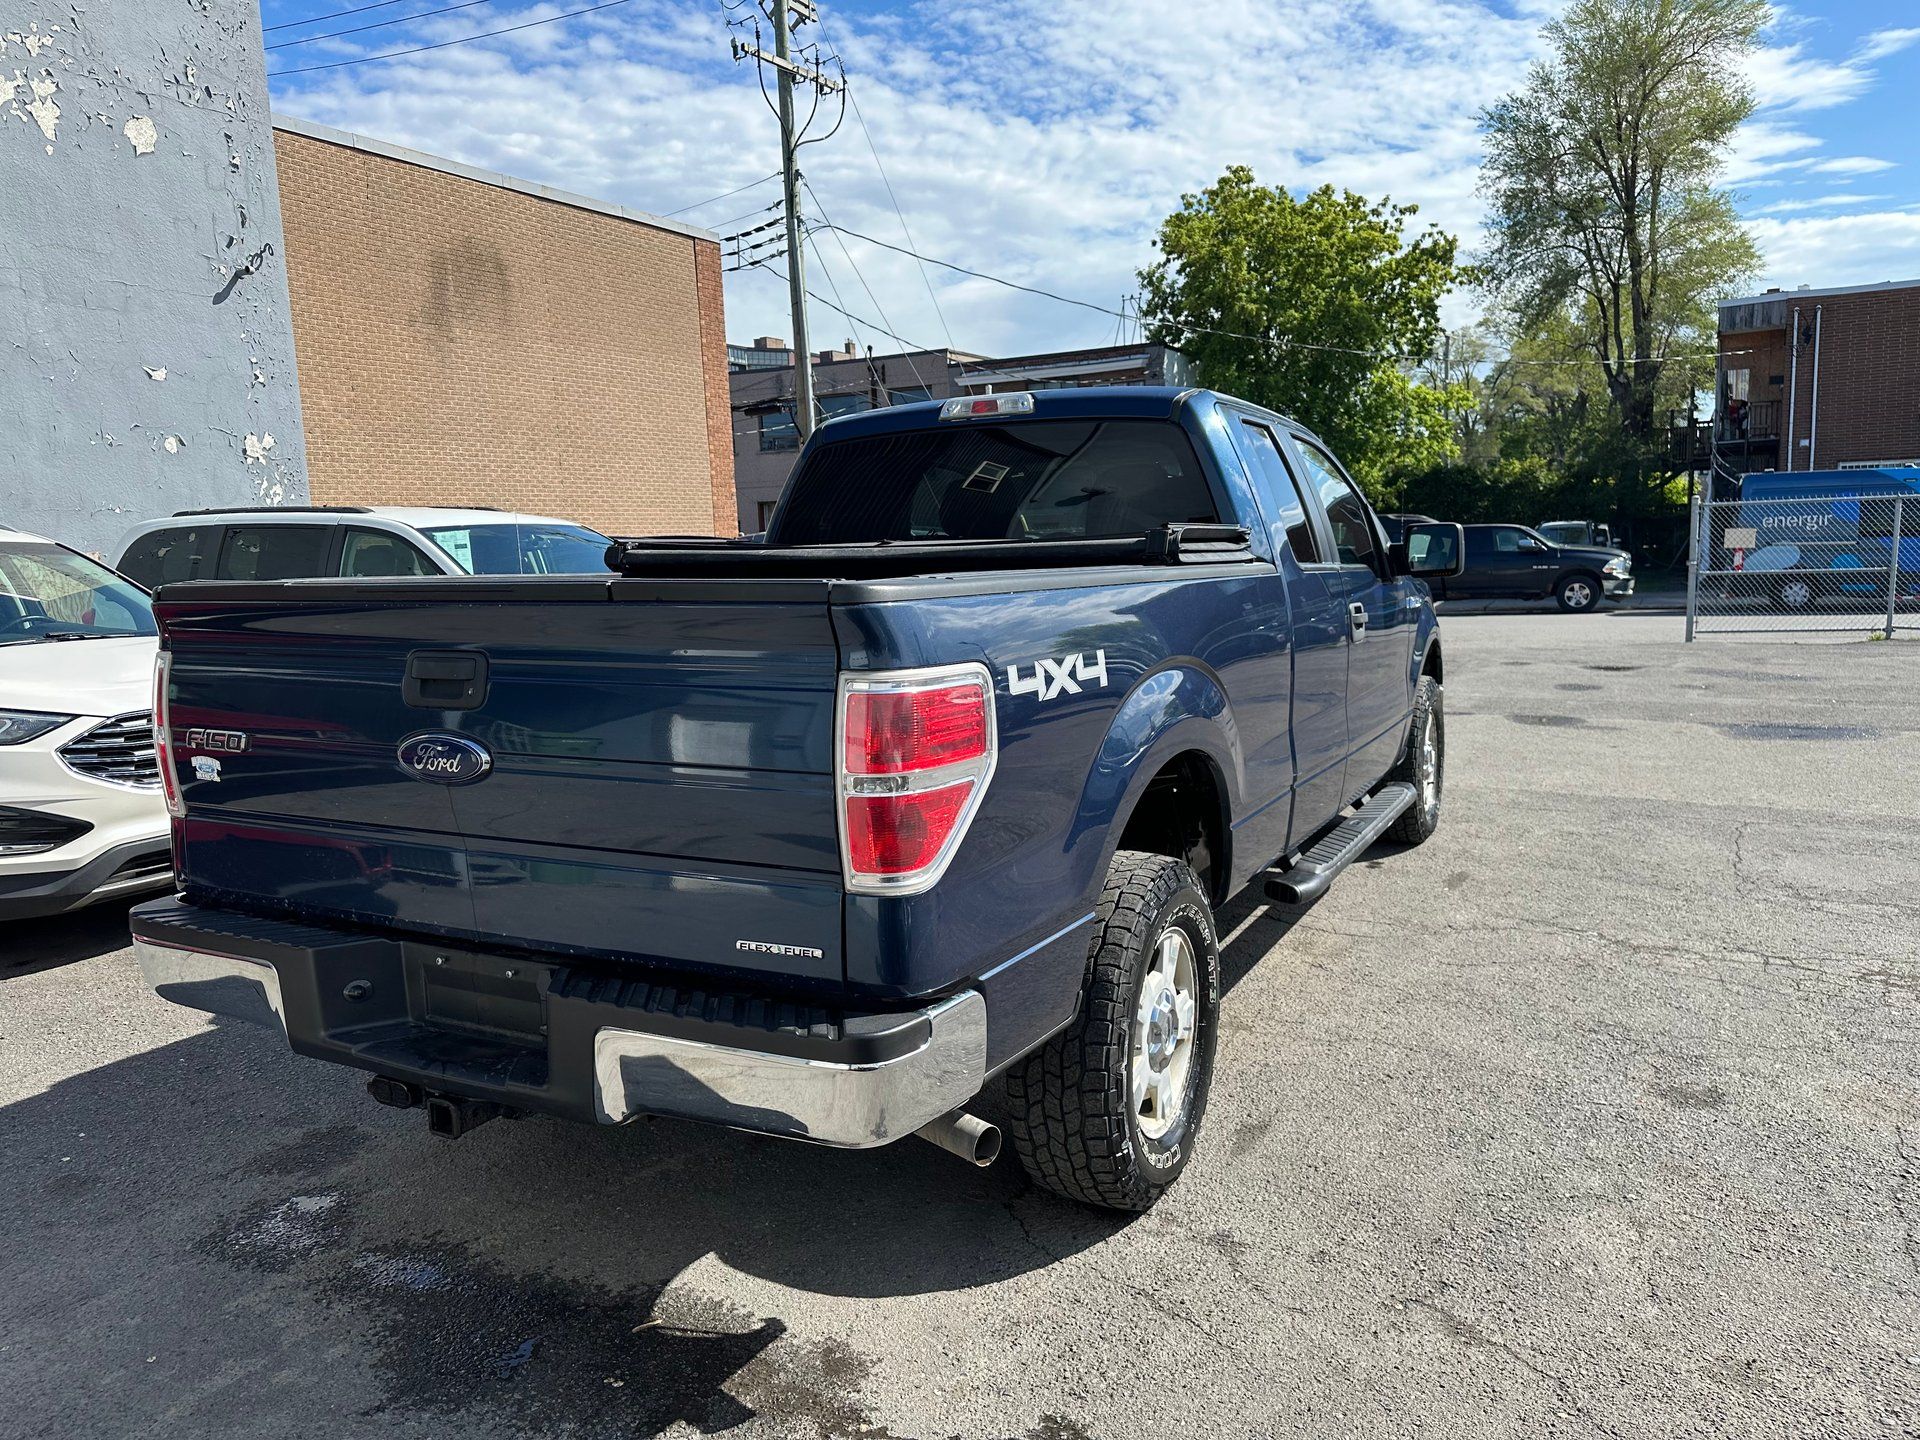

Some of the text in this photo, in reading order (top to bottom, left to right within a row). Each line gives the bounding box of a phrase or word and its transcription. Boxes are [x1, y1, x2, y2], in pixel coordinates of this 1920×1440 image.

[1762, 514, 1832, 531] energir
[413, 743, 462, 773] Ford
[740, 941, 822, 959] FLEX FUEL
